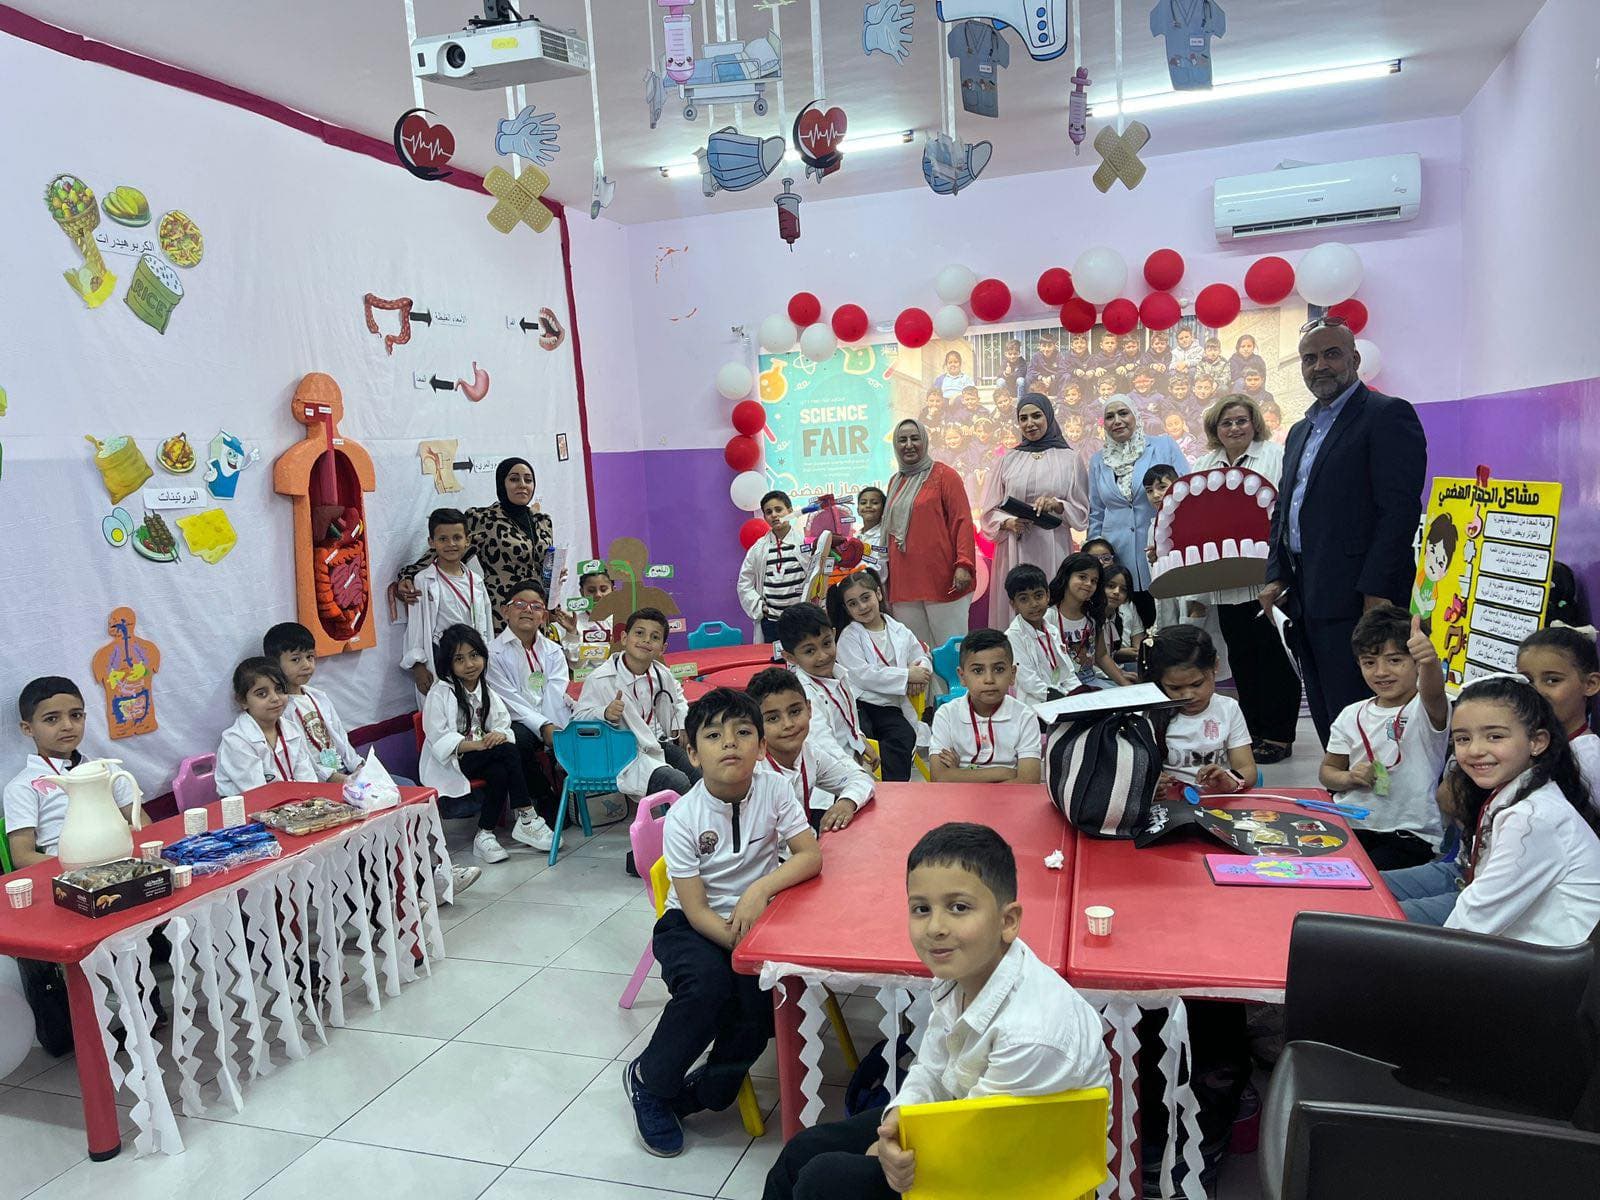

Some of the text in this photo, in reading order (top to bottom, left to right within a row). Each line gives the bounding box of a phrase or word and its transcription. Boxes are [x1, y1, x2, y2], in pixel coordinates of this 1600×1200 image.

[96, 233, 155, 254] الكربوهيدرات
[131, 278, 168, 318] RICE
[799, 404, 869, 424] SCIENCE
[802, 425, 870, 457] FAIR
[157, 490, 200, 504] البروتينات
[1438, 483, 1540, 508] مشاكل الجهاز الهضمي
